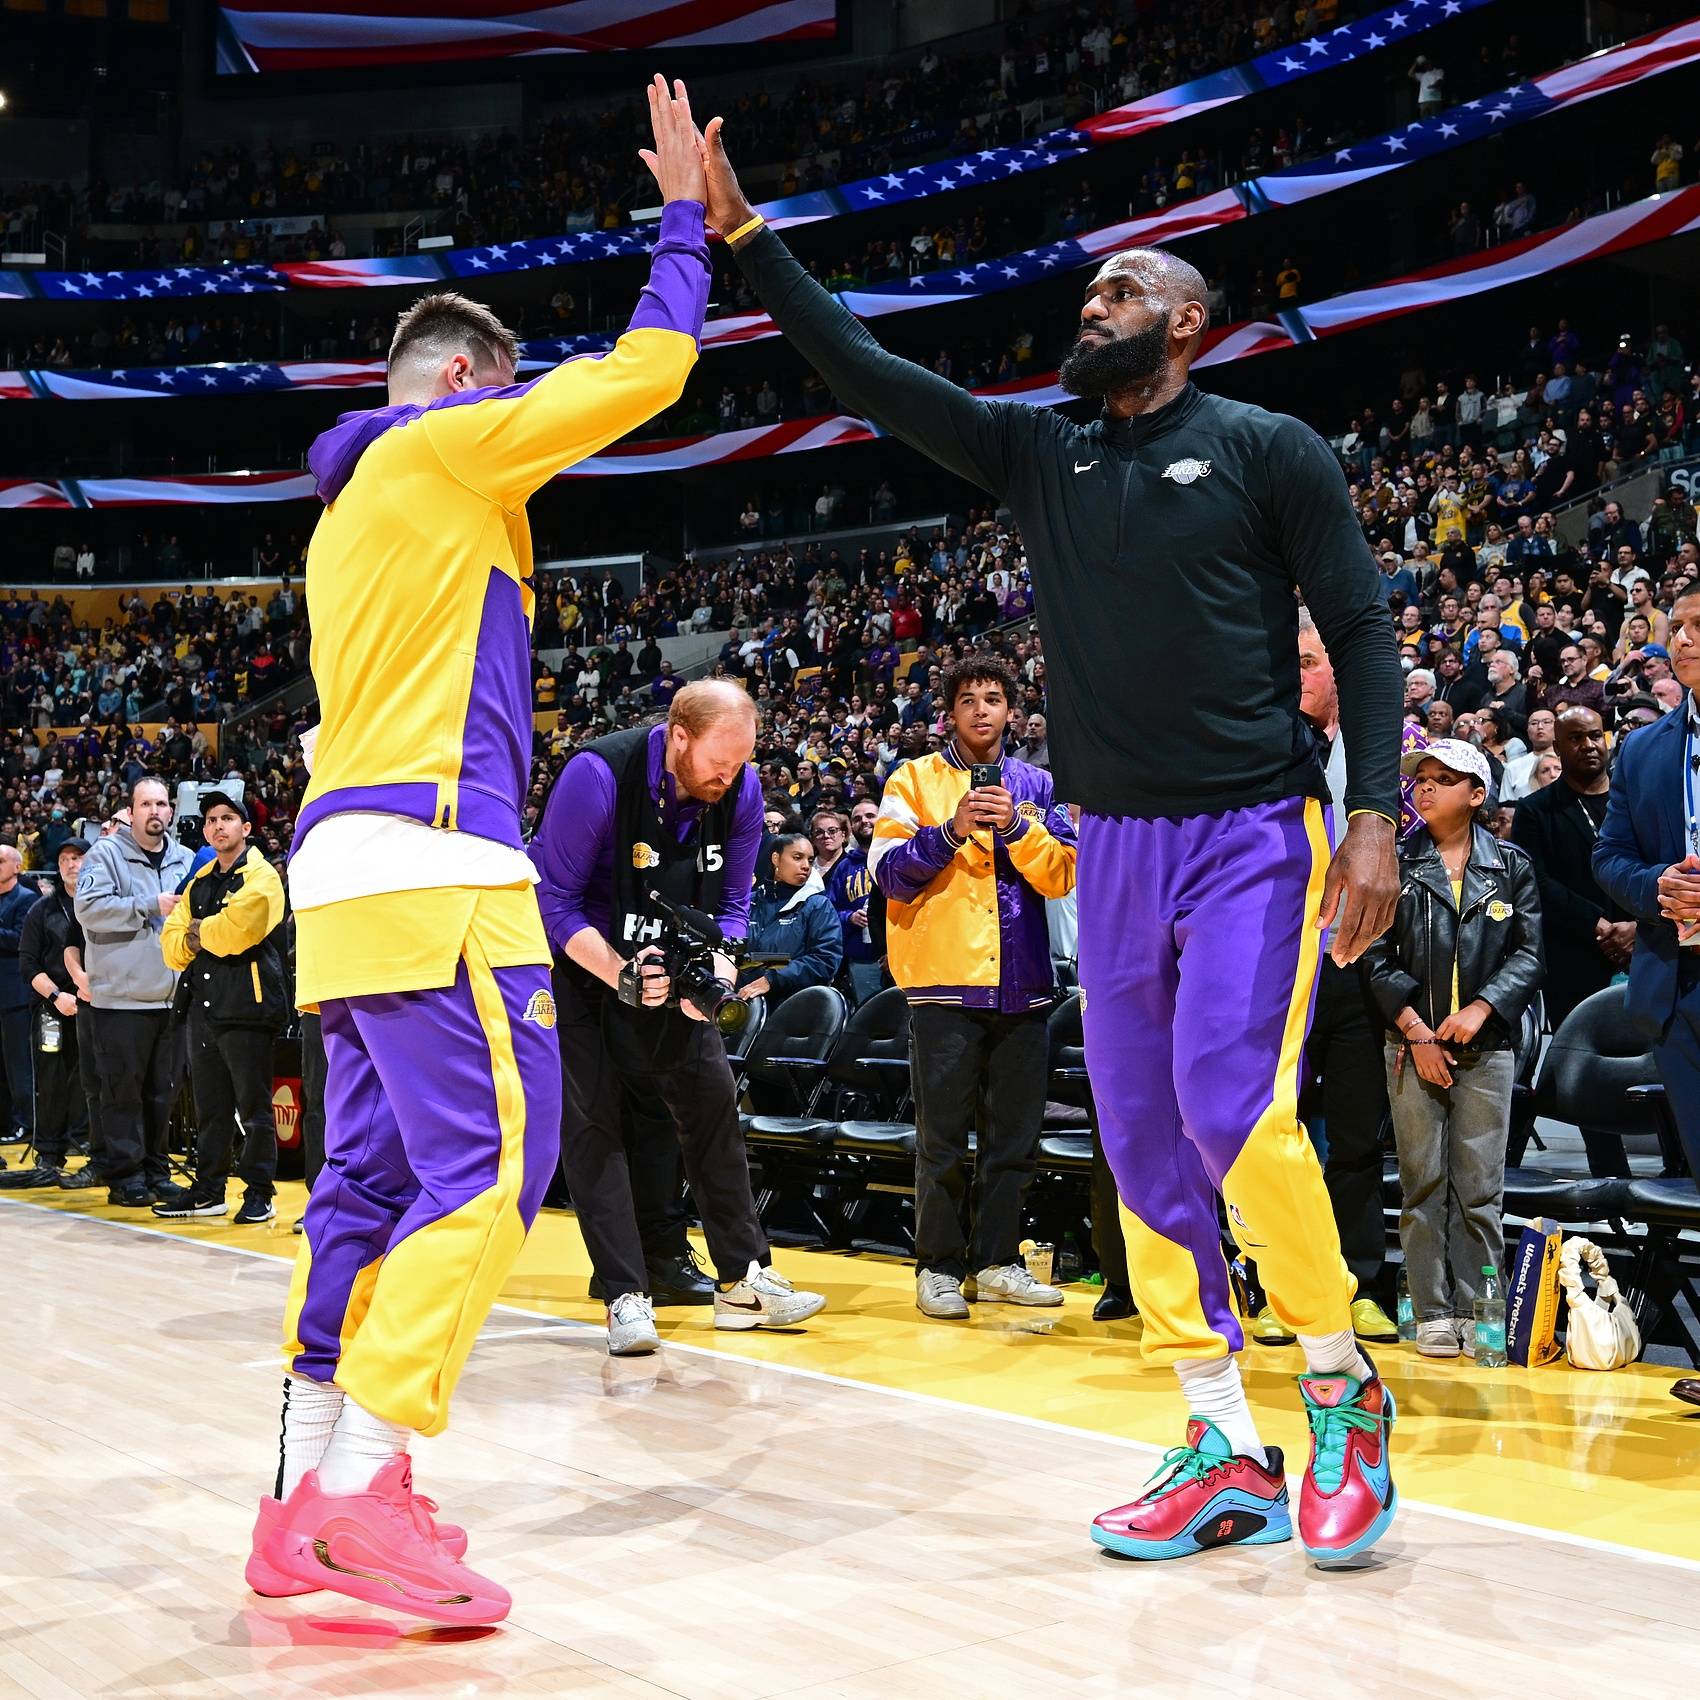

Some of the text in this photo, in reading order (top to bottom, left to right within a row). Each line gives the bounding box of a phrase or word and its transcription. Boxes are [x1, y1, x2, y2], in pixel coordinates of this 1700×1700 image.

[272, 1104, 298, 1126] TNT
[1506, 1242, 1536, 1348] Wetzel's Pretzels
